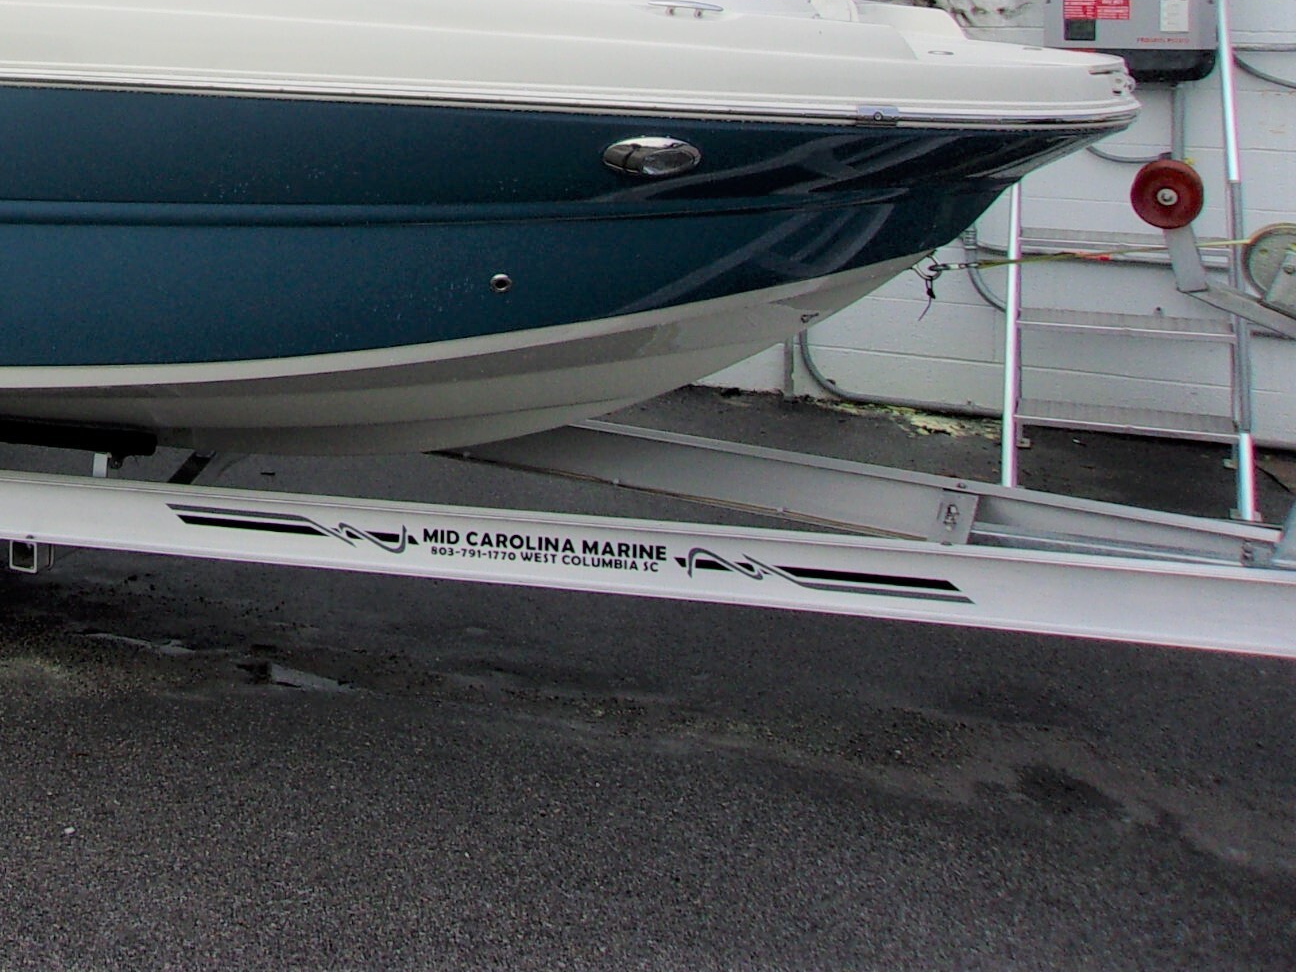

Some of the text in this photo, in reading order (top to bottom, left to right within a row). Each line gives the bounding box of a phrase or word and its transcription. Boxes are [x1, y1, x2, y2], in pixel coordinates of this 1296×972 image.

[423, 528, 667, 561] MID CAROLINA MARINE
[431, 546, 659, 573] 803-791-1770 WEST COLUMBIA SC
